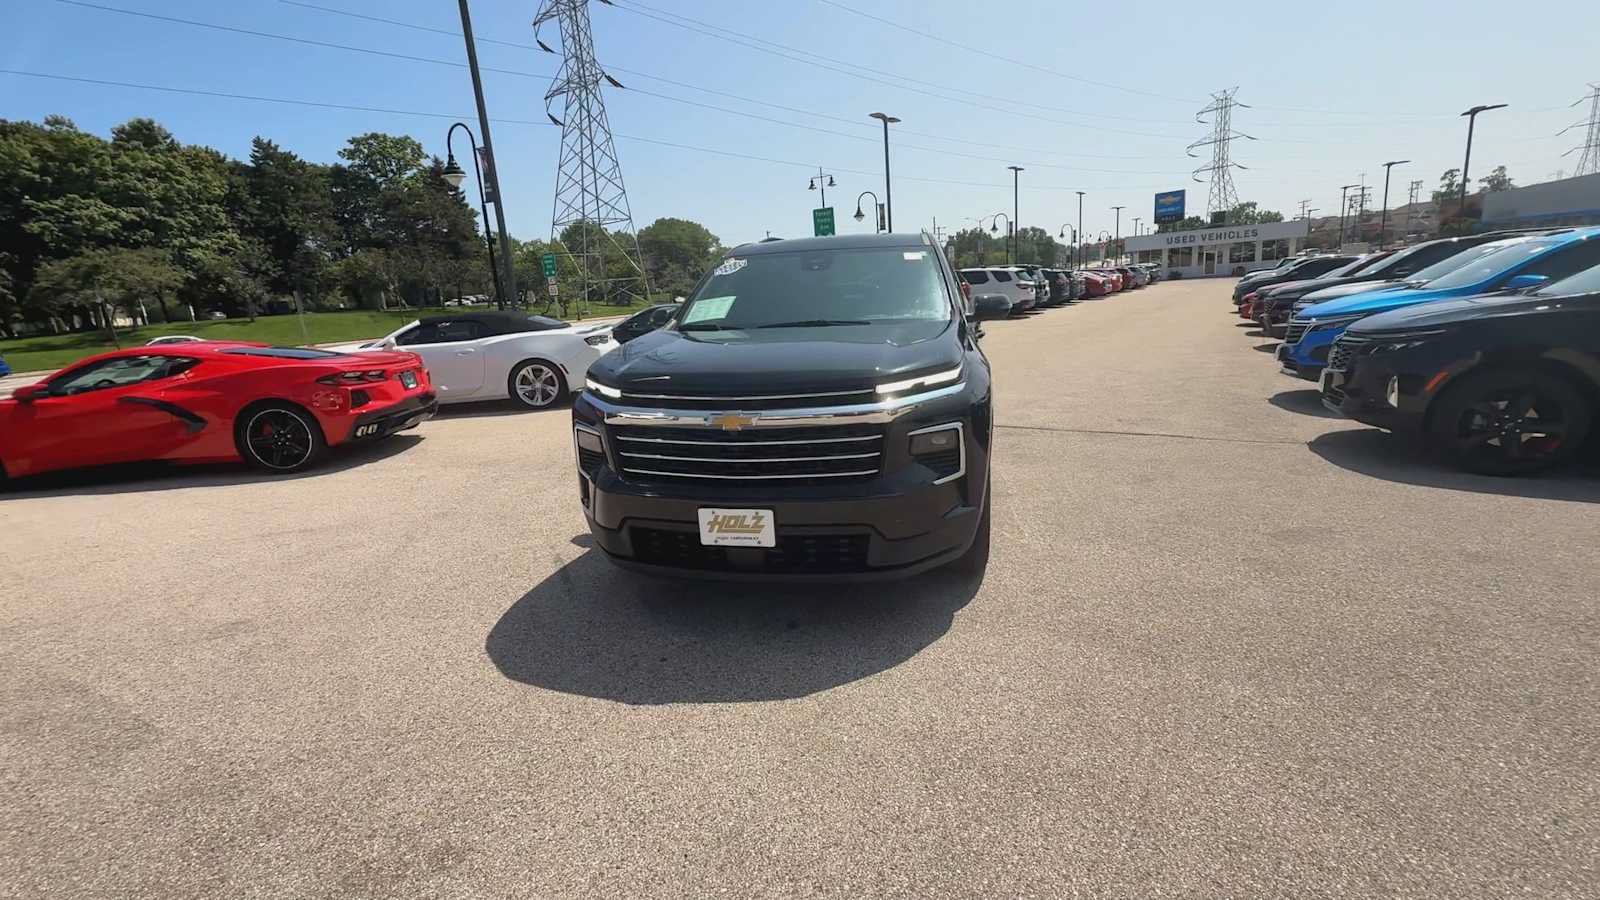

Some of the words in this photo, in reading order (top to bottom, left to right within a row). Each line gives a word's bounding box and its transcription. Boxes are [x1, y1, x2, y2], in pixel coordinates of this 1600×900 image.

[1166, 235, 1196, 244] USED
[1201, 229, 1258, 241] VEHICLES
[707, 514, 766, 533] HOLZ
